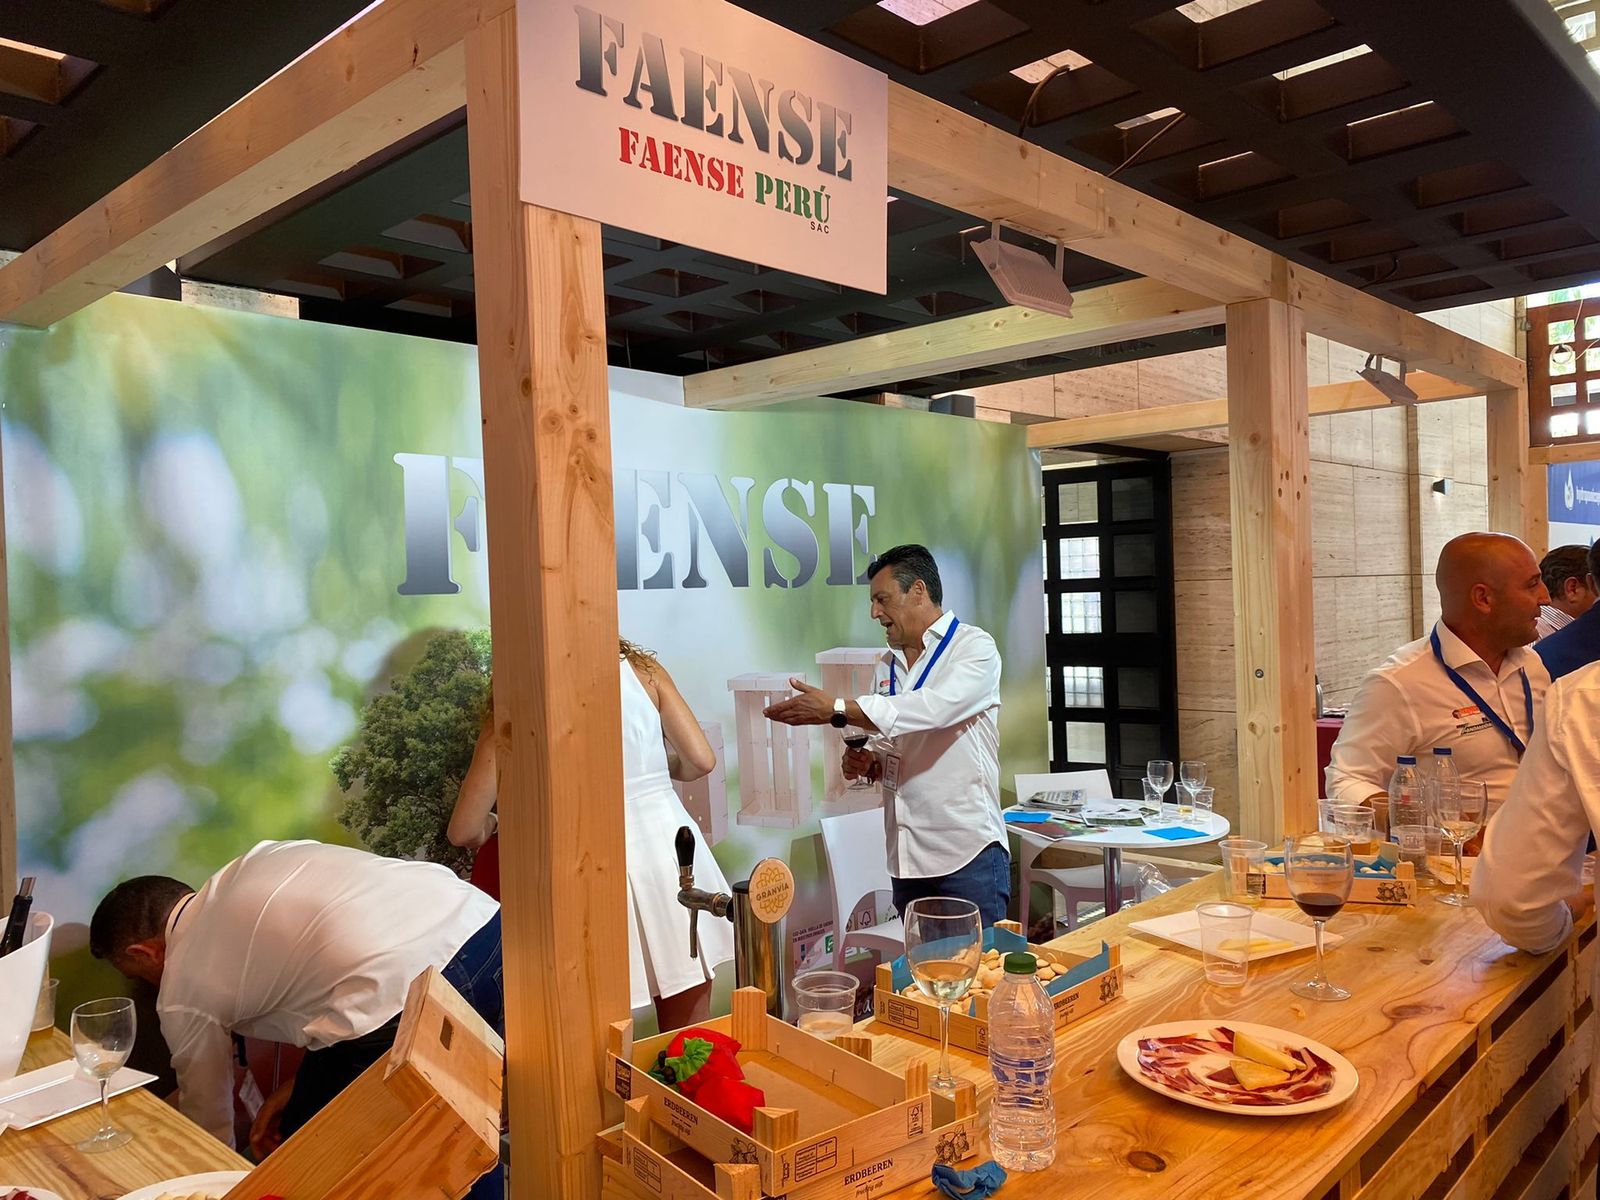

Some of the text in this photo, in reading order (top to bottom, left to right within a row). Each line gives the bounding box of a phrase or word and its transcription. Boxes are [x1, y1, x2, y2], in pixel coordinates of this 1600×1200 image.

[574, 4, 853, 182] FAENSE
[618, 126, 831, 224] FAENSE PERÚ
[810, 220, 830, 234] SAC
[393, 452, 876, 595] FENSE
[844, 1157, 894, 1186] ERDBEEREN
